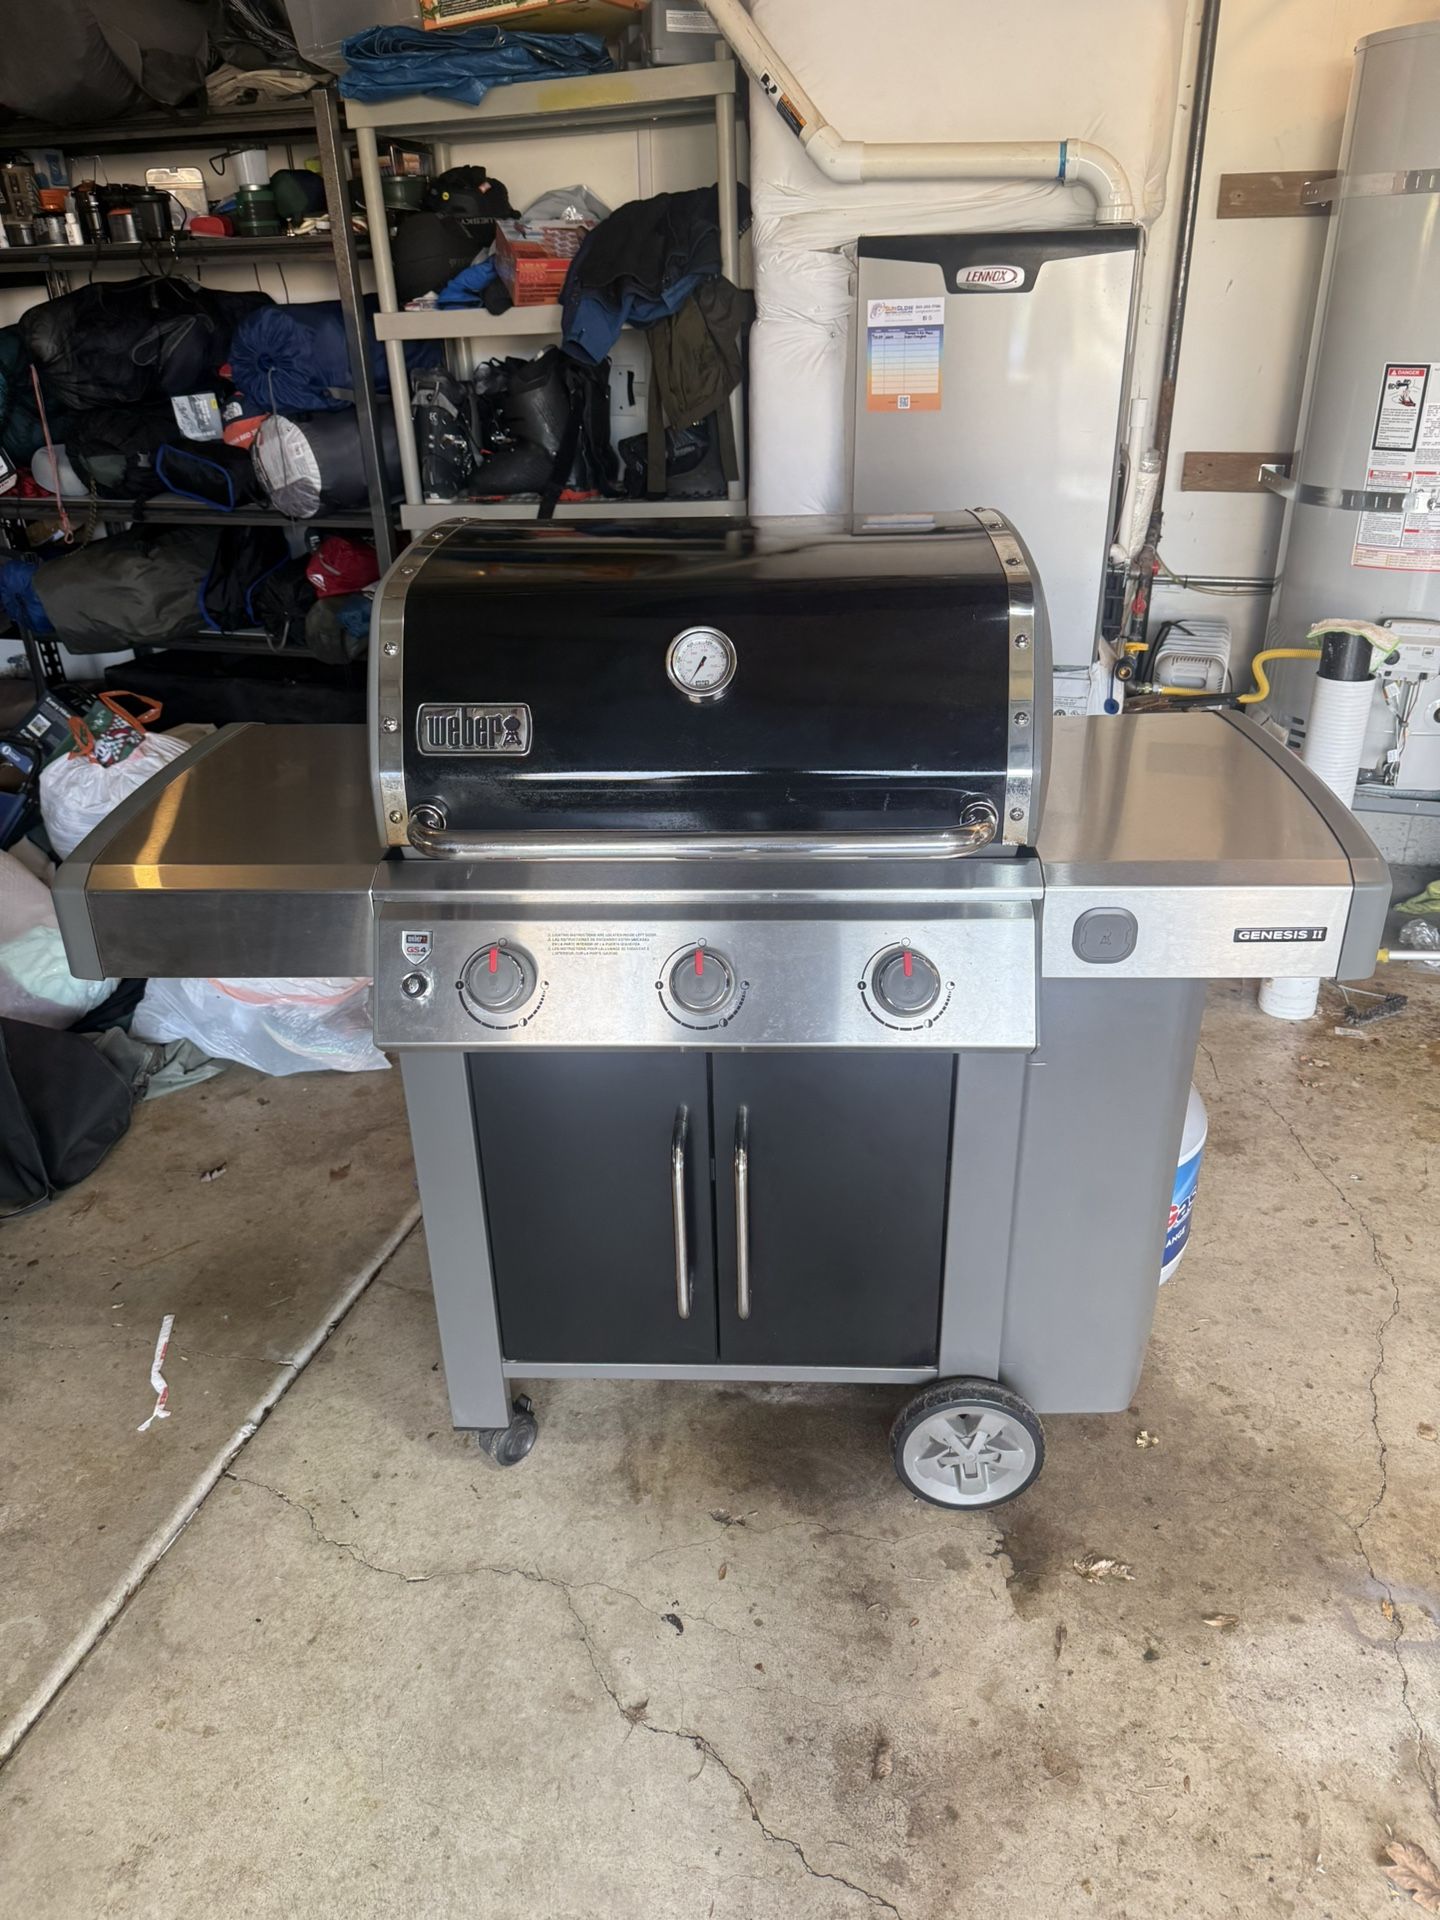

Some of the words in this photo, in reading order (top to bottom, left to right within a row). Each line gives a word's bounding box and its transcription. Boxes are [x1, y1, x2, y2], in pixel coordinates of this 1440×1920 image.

[965, 270, 1008, 282] LENNOX
[426, 707, 504, 749] weber
[1238, 930, 1308, 940] GENESIS
[1312, 930, 1323, 939] II
